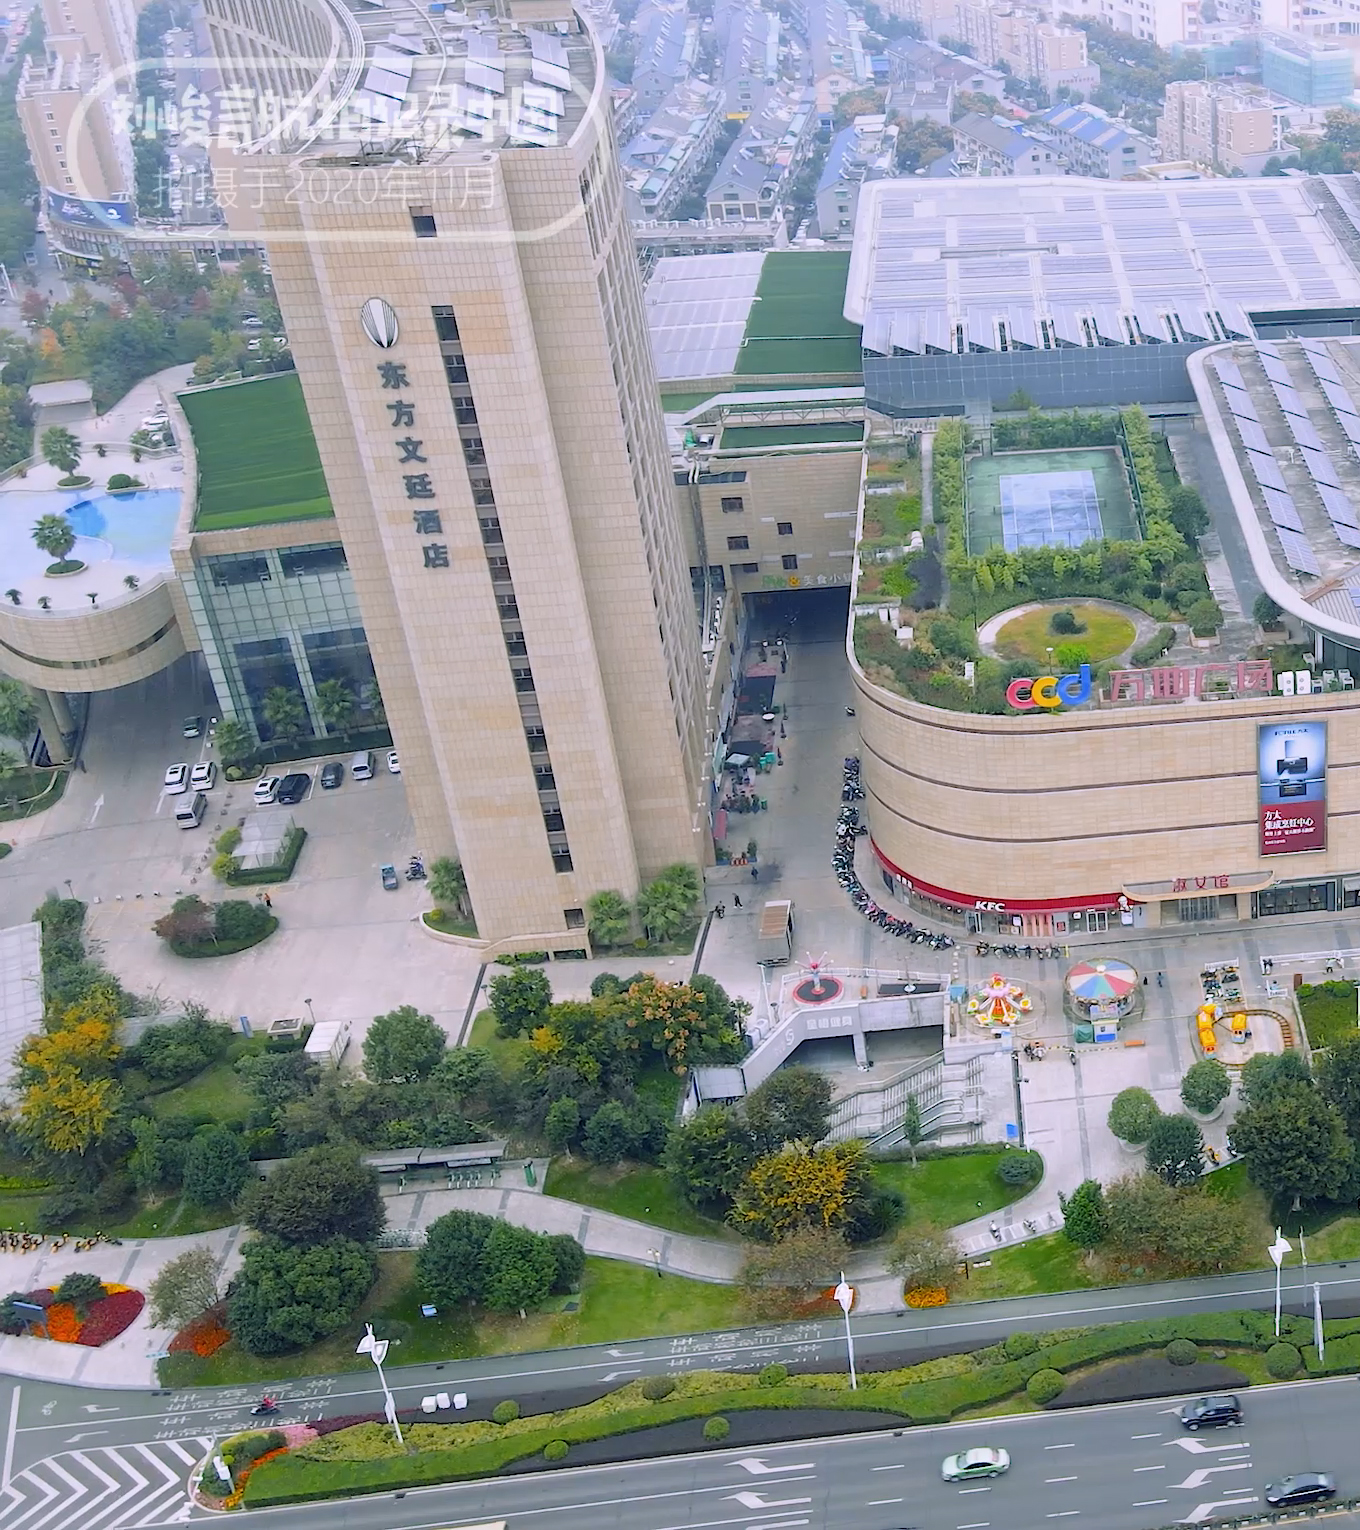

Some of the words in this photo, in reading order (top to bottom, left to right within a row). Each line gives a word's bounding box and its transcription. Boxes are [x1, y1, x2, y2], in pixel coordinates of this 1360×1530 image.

[377, 361, 450, 568] 东方文廷酒店
[1006, 664, 1091, 710] ccd
[975, 901, 1005, 912] KFC
